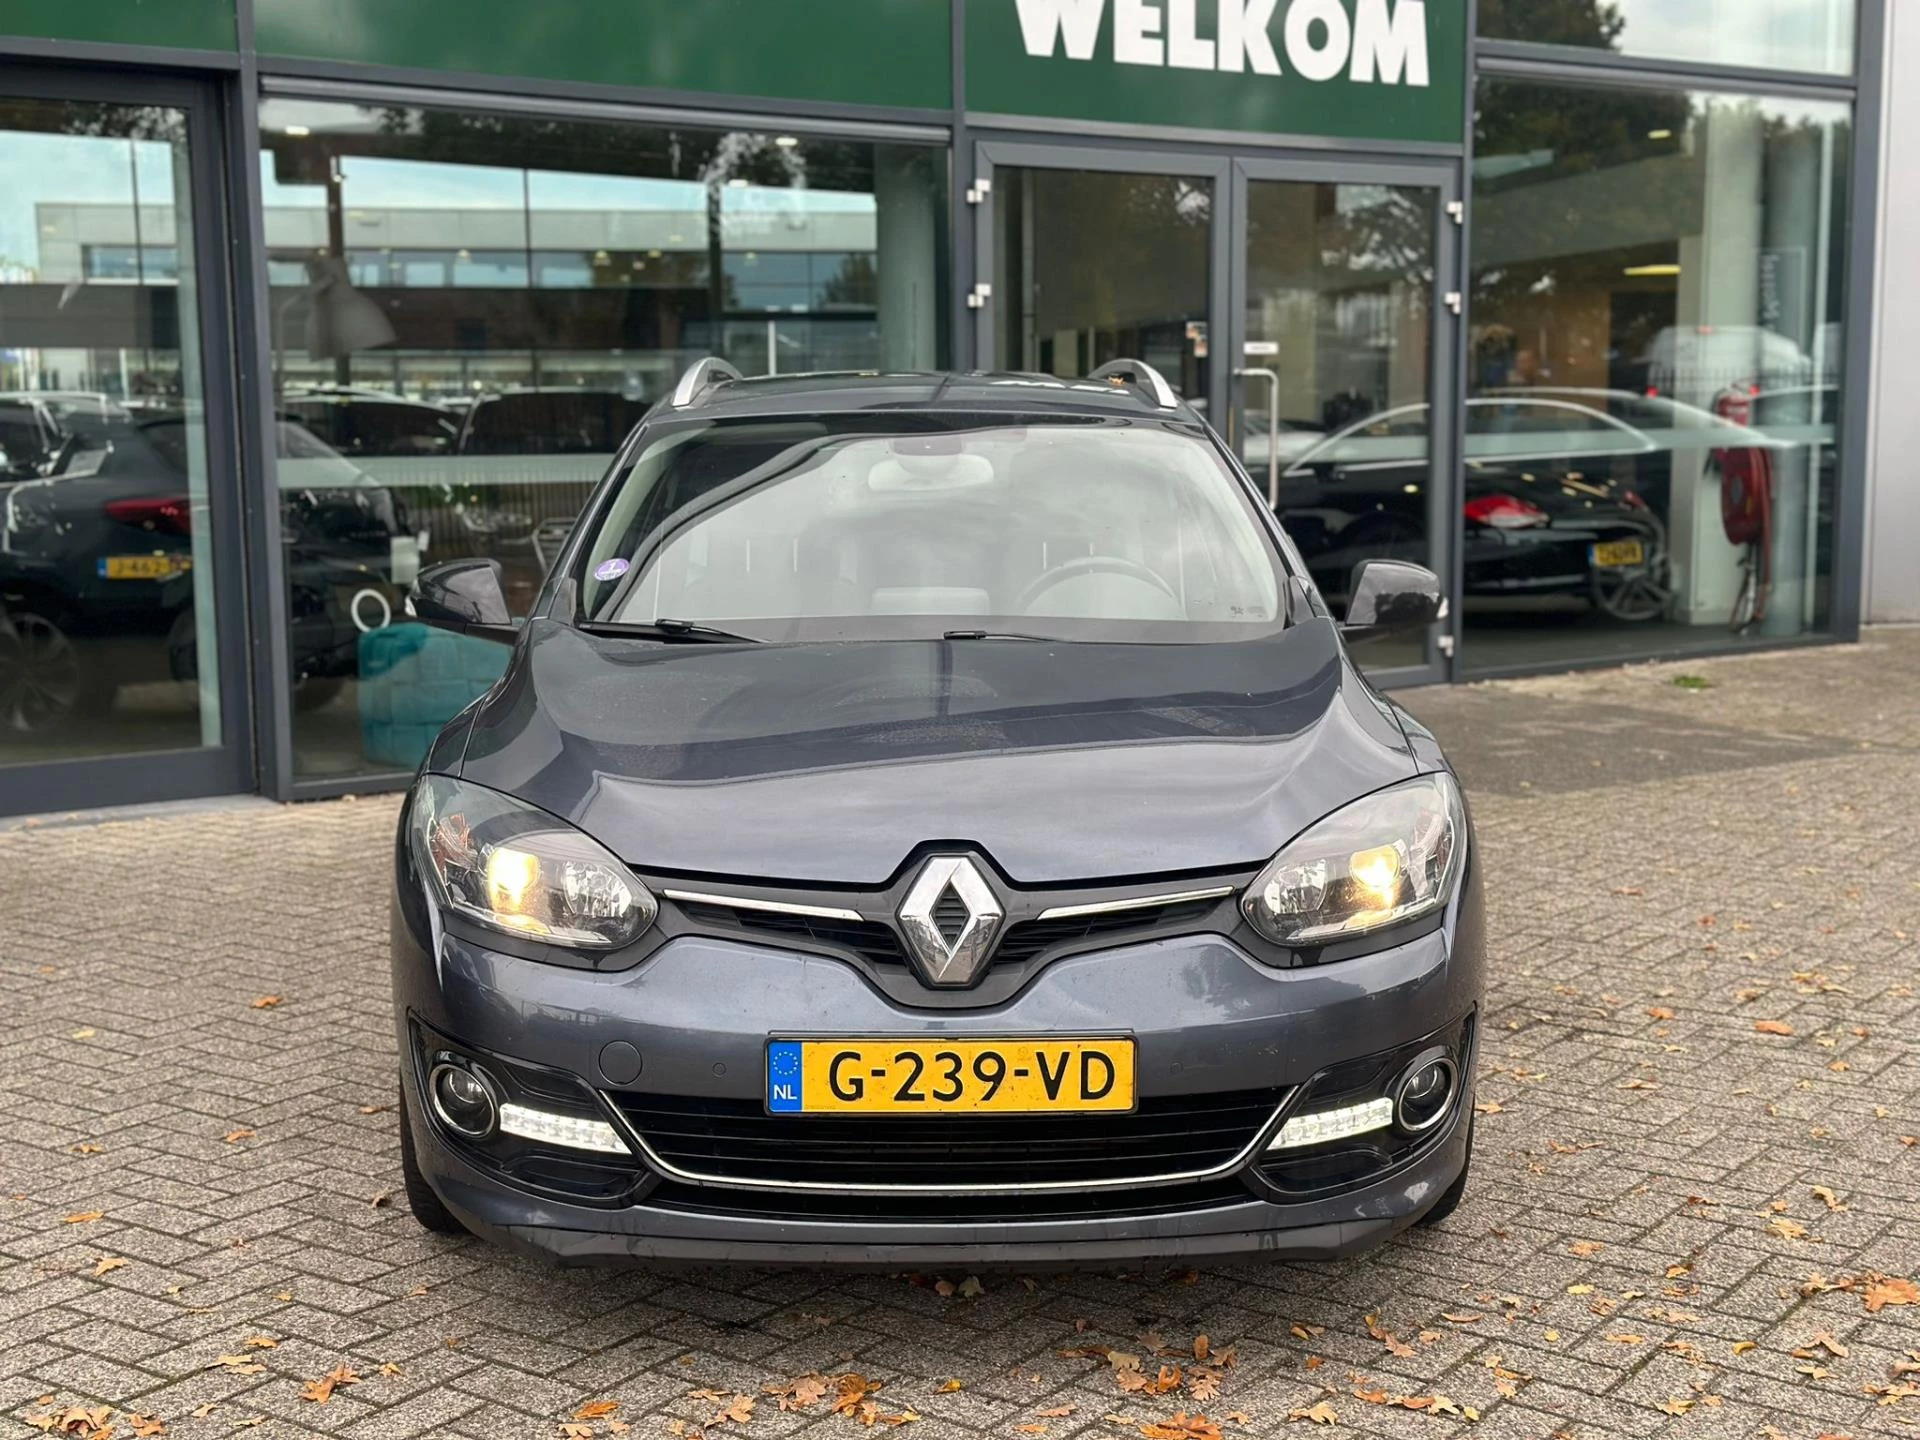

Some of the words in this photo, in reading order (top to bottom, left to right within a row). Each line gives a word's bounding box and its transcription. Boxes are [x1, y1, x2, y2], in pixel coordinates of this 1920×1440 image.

[1015, 0, 1430, 86] WELKOM
[773, 1084, 798, 1100] NL
[828, 1051, 1115, 1102] G-239-VD
